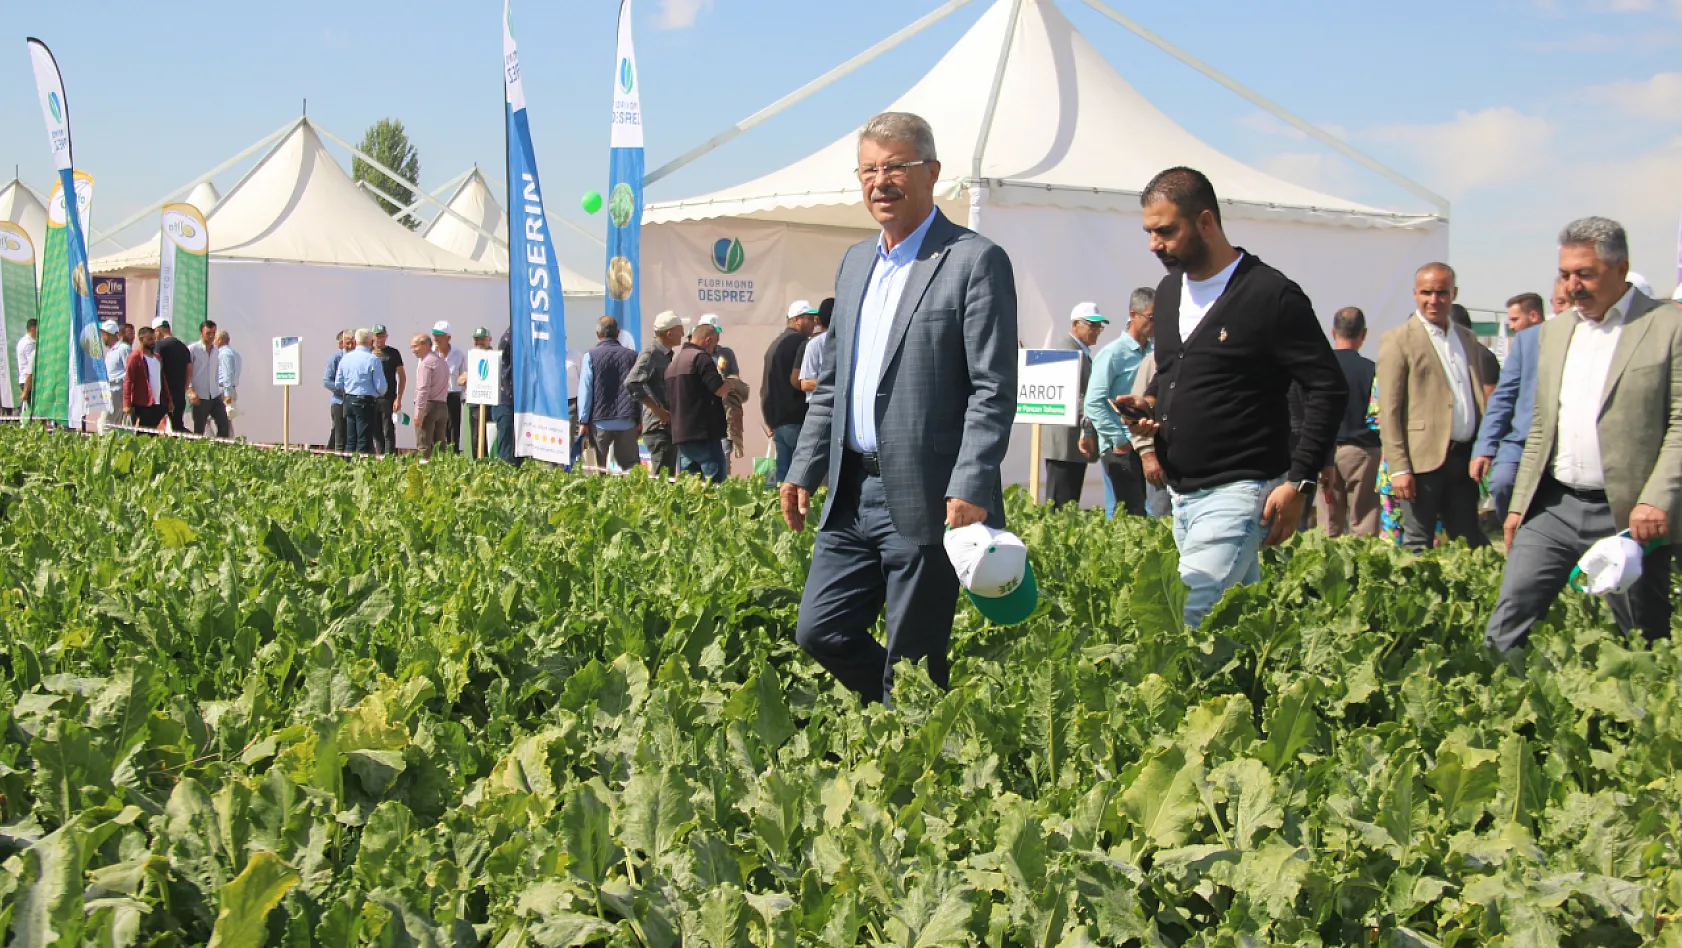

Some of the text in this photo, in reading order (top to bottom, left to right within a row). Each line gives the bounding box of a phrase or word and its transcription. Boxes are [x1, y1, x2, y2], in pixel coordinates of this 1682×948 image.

[521, 173, 550, 346] TISSERIN
[698, 278, 753, 288] FLORIMOND
[698, 289, 754, 302] DESPREZ
[1019, 384, 1065, 400] ARROT
